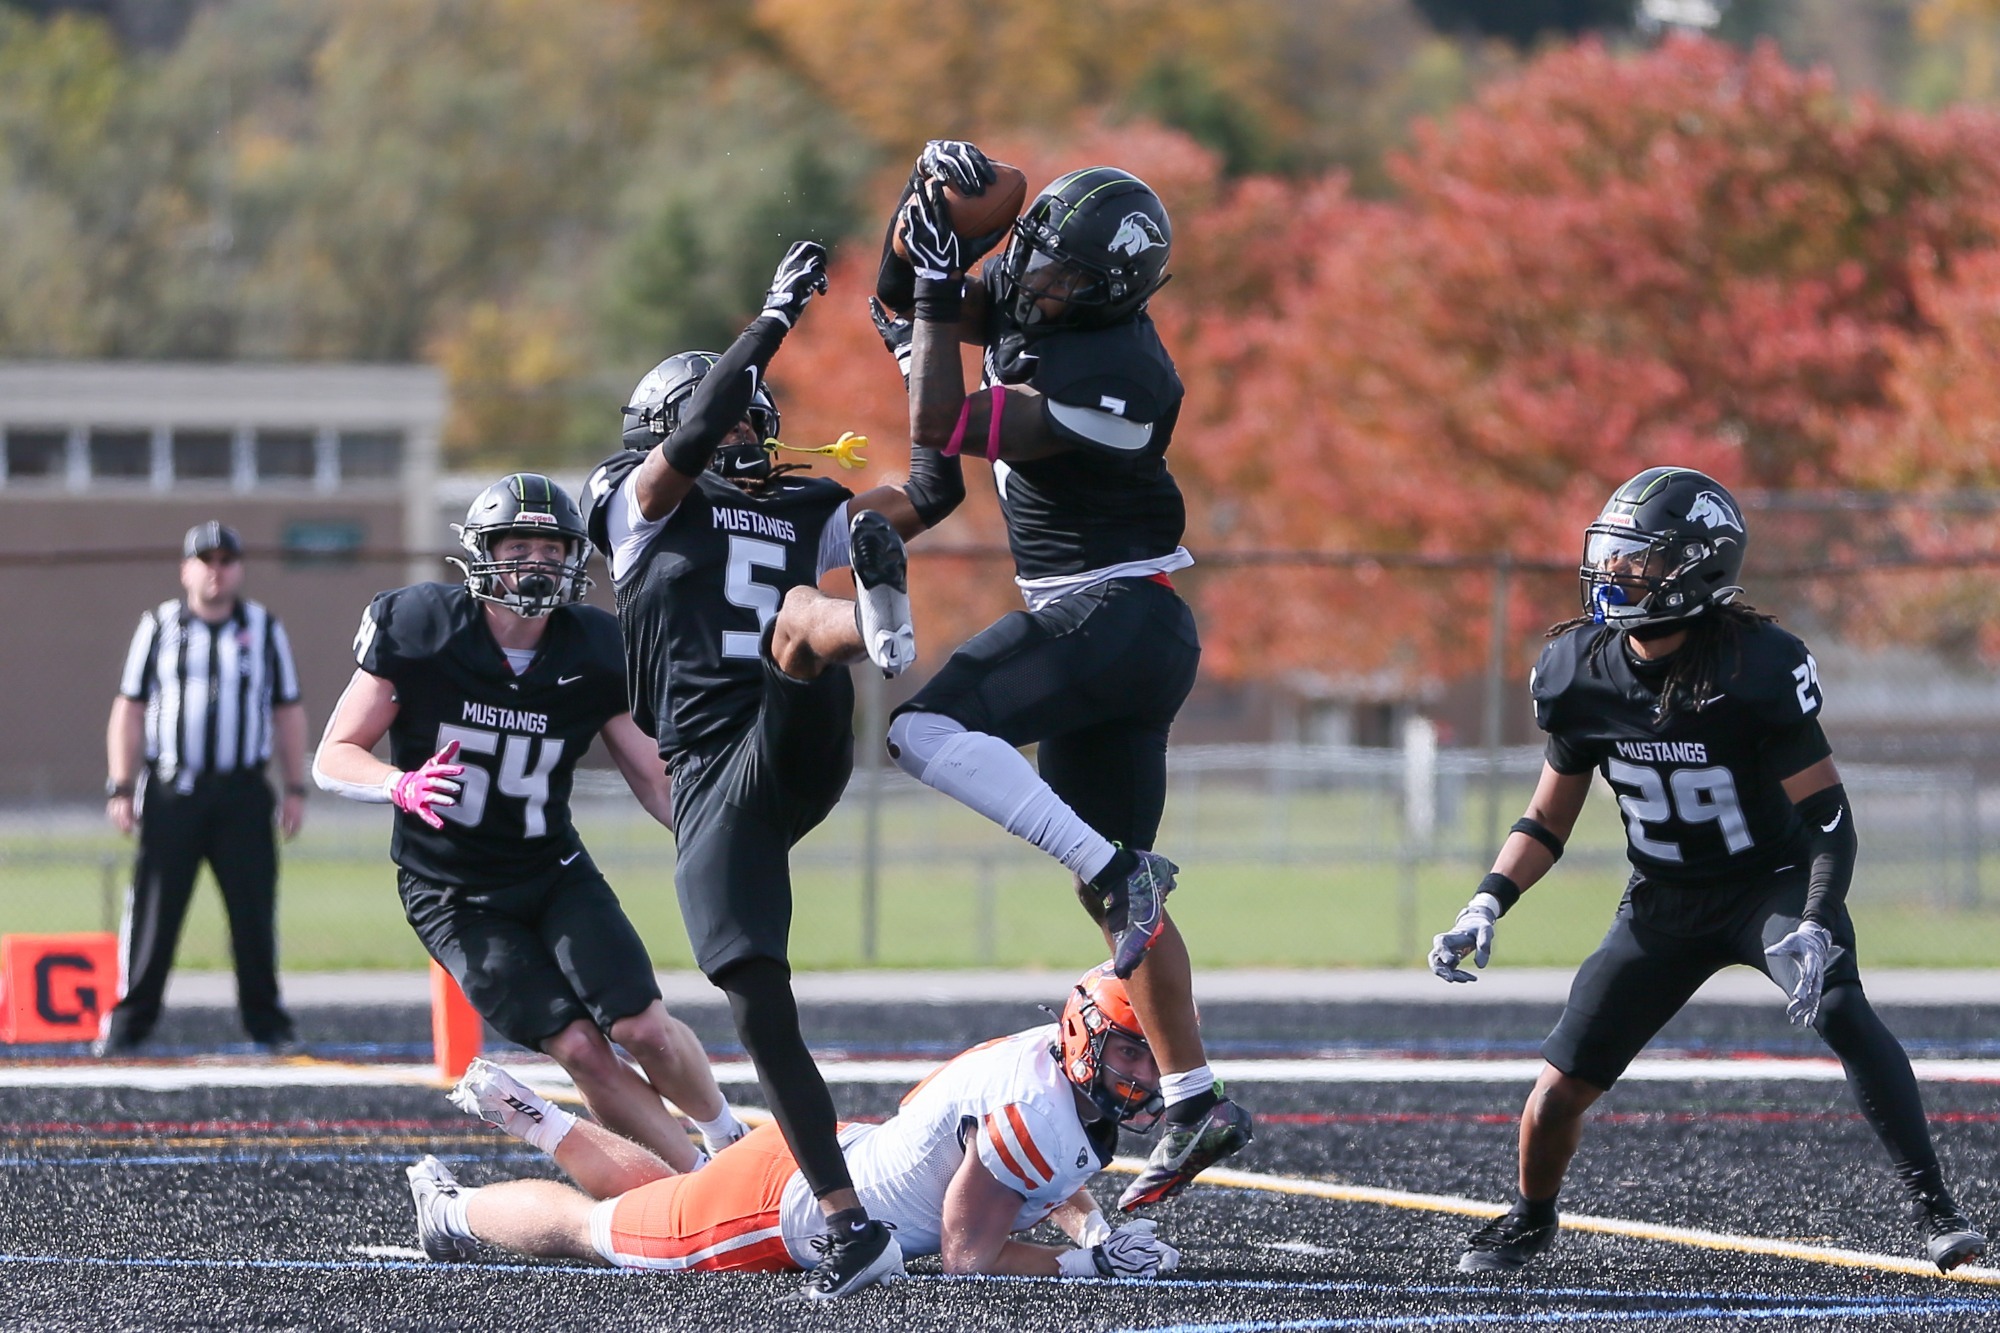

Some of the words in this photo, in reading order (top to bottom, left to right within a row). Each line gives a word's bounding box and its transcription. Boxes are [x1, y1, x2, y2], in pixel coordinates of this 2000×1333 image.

[712, 507, 796, 542] MUSTANGS
[722, 534, 786, 658] 5
[1792, 654, 1823, 714] 29
[462, 701, 548, 734] MUSTANGS
[436, 722, 565, 838] 54
[1615, 741, 1708, 763] MUSTANGS
[1608, 756, 1755, 863] 29
[35, 954, 97, 1024] G
